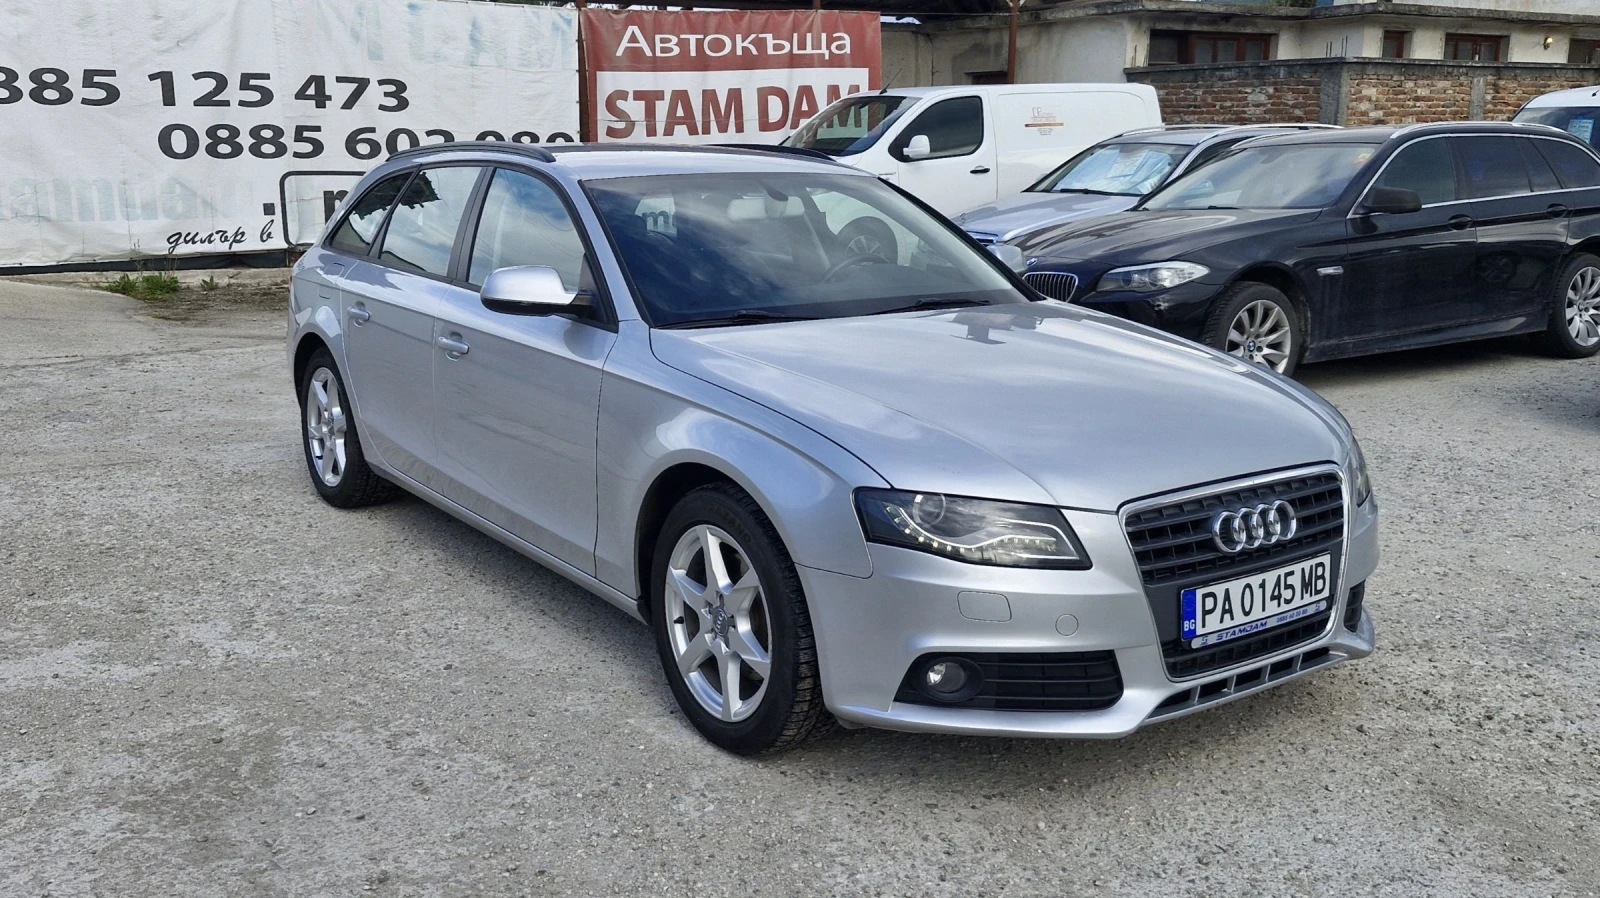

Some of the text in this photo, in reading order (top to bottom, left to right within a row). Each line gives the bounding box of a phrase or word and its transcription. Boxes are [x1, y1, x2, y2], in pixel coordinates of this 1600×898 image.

[615, 25, 851, 60] Автокъща
[147, 71, 274, 108] 125
[294, 75, 409, 112] 473
[604, 84, 862, 139] STAM DAM
[158, 123, 325, 160] 0885
[166, 226, 247, 254] дилър
[1184, 619, 1195, 632] BG
